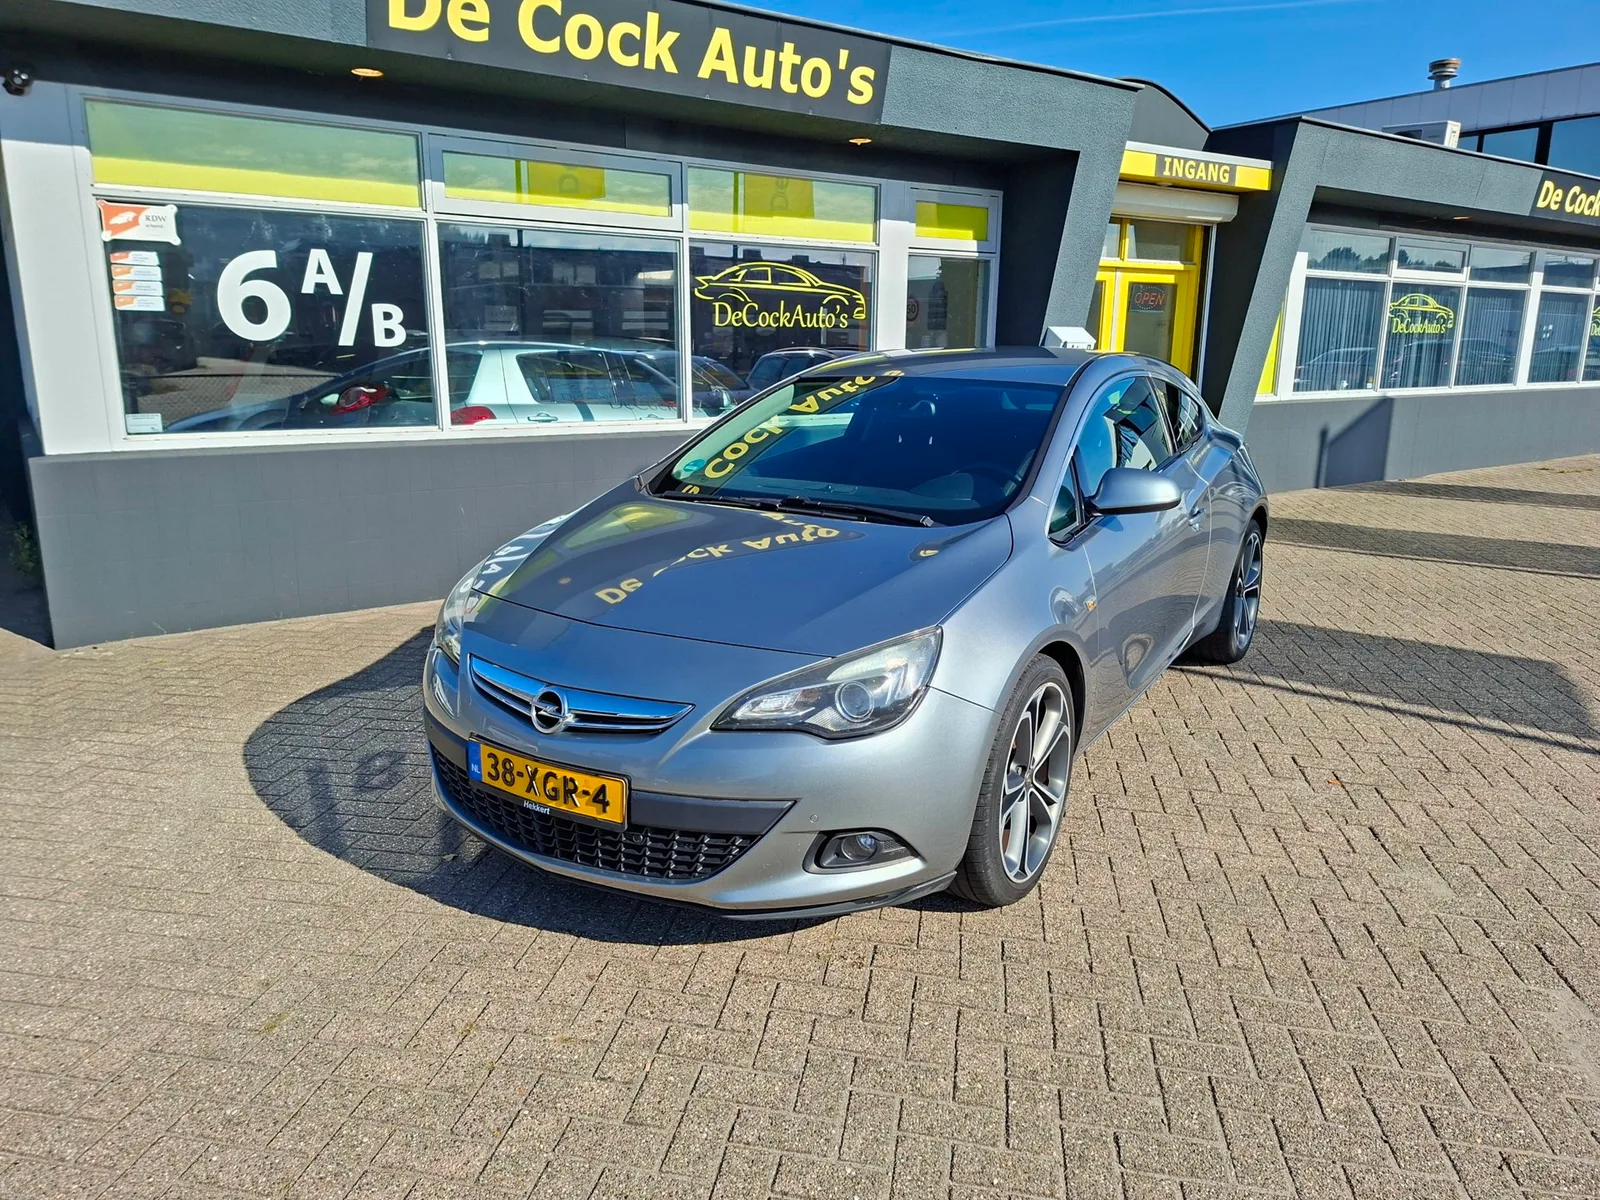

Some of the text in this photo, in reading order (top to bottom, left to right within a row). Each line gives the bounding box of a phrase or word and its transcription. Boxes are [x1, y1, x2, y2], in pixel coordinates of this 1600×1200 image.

[517, 0, 681, 74] Cock
[697, 26, 875, 105] Auto's
[1163, 157, 1230, 183] INGANG
[1536, 180, 1563, 210] De
[145, 214, 168, 222] RDW
[217, 250, 291, 341] 6
[1134, 292, 1165, 306] OPEN
[712, 300, 848, 329] DeCockAuto's
[1392, 316, 1446, 334] DeCockAuto's
[471, 763, 481, 774] NL
[487, 752, 611, 814] 38-XGR-4
[523, 801, 550, 815] Hekkert
